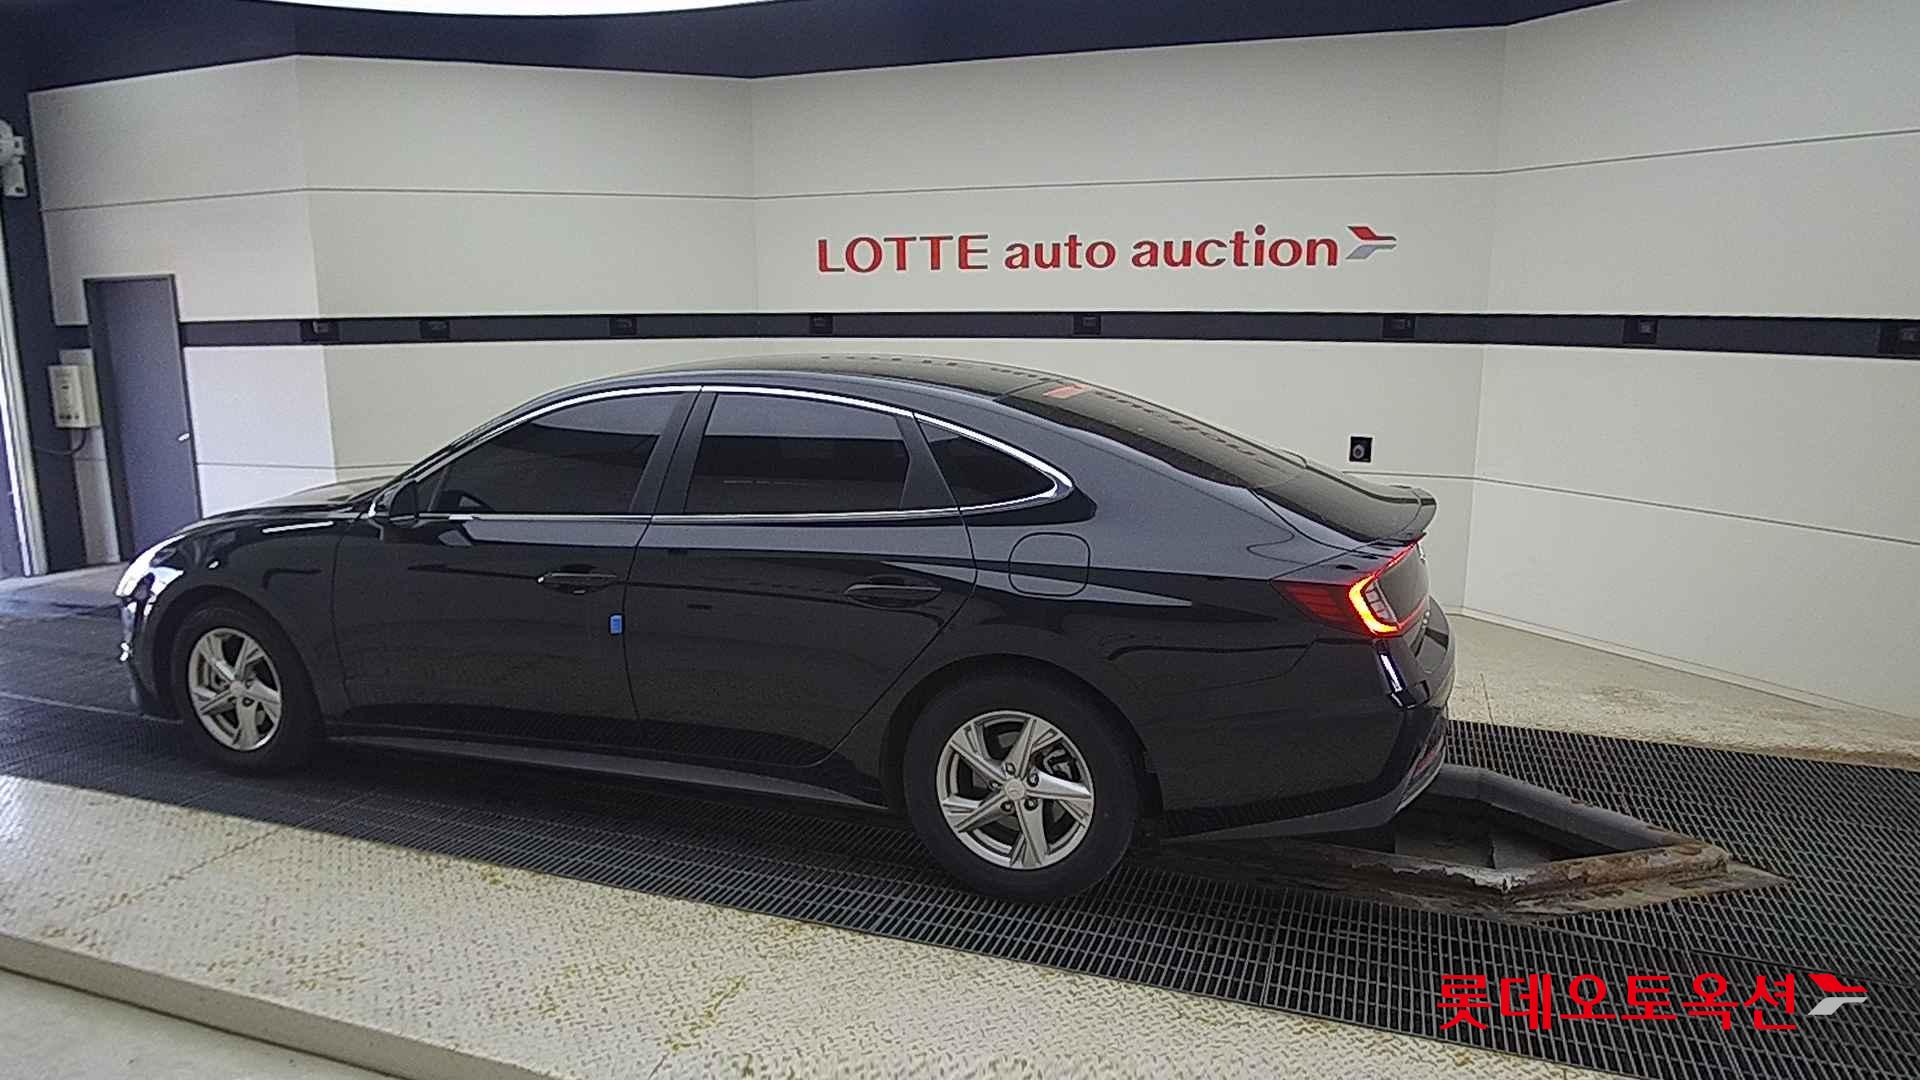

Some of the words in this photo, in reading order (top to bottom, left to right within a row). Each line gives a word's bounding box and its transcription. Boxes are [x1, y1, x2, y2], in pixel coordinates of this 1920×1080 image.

[817, 233, 989, 273] LOTTE
[1004, 233, 1117, 270] auto
[1131, 225, 1339, 269] auction
